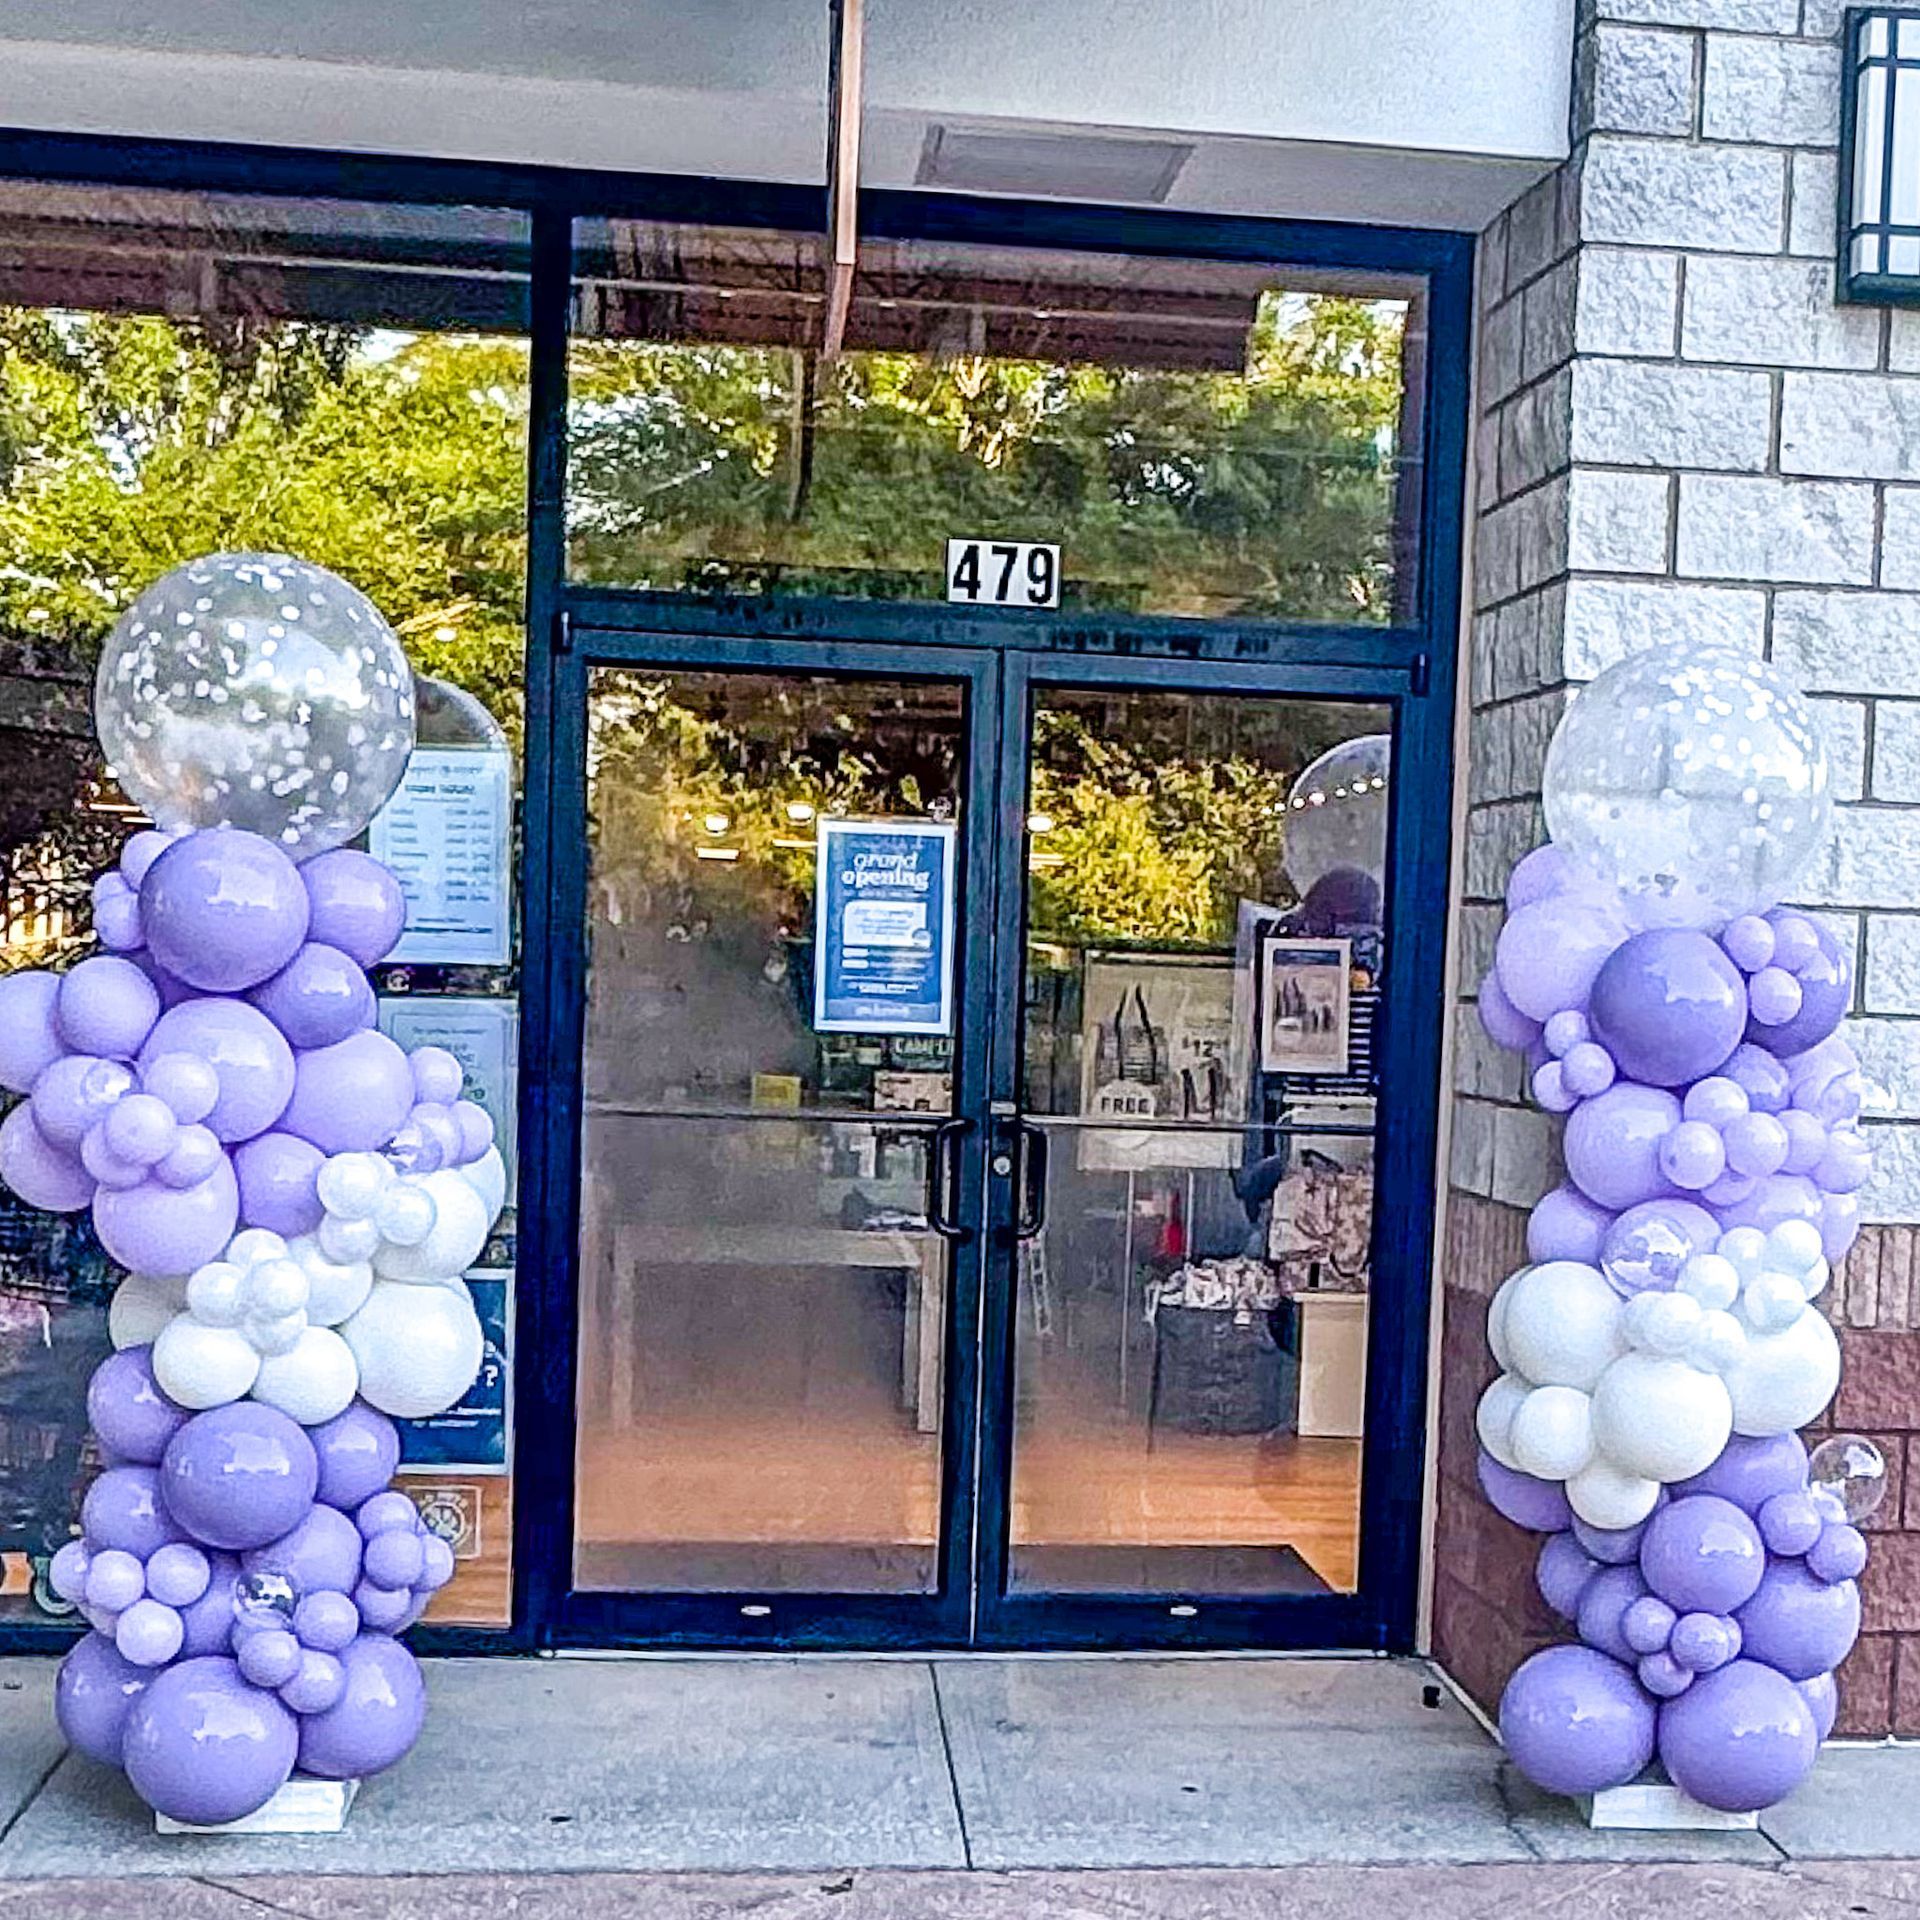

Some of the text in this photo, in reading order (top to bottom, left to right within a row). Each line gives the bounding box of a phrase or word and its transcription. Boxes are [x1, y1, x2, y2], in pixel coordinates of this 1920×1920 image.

[952, 544, 1054, 604] 479
[853, 851, 919, 871] grand
[841, 870, 930, 891] opening
[1101, 1097, 1150, 1114] FREE
